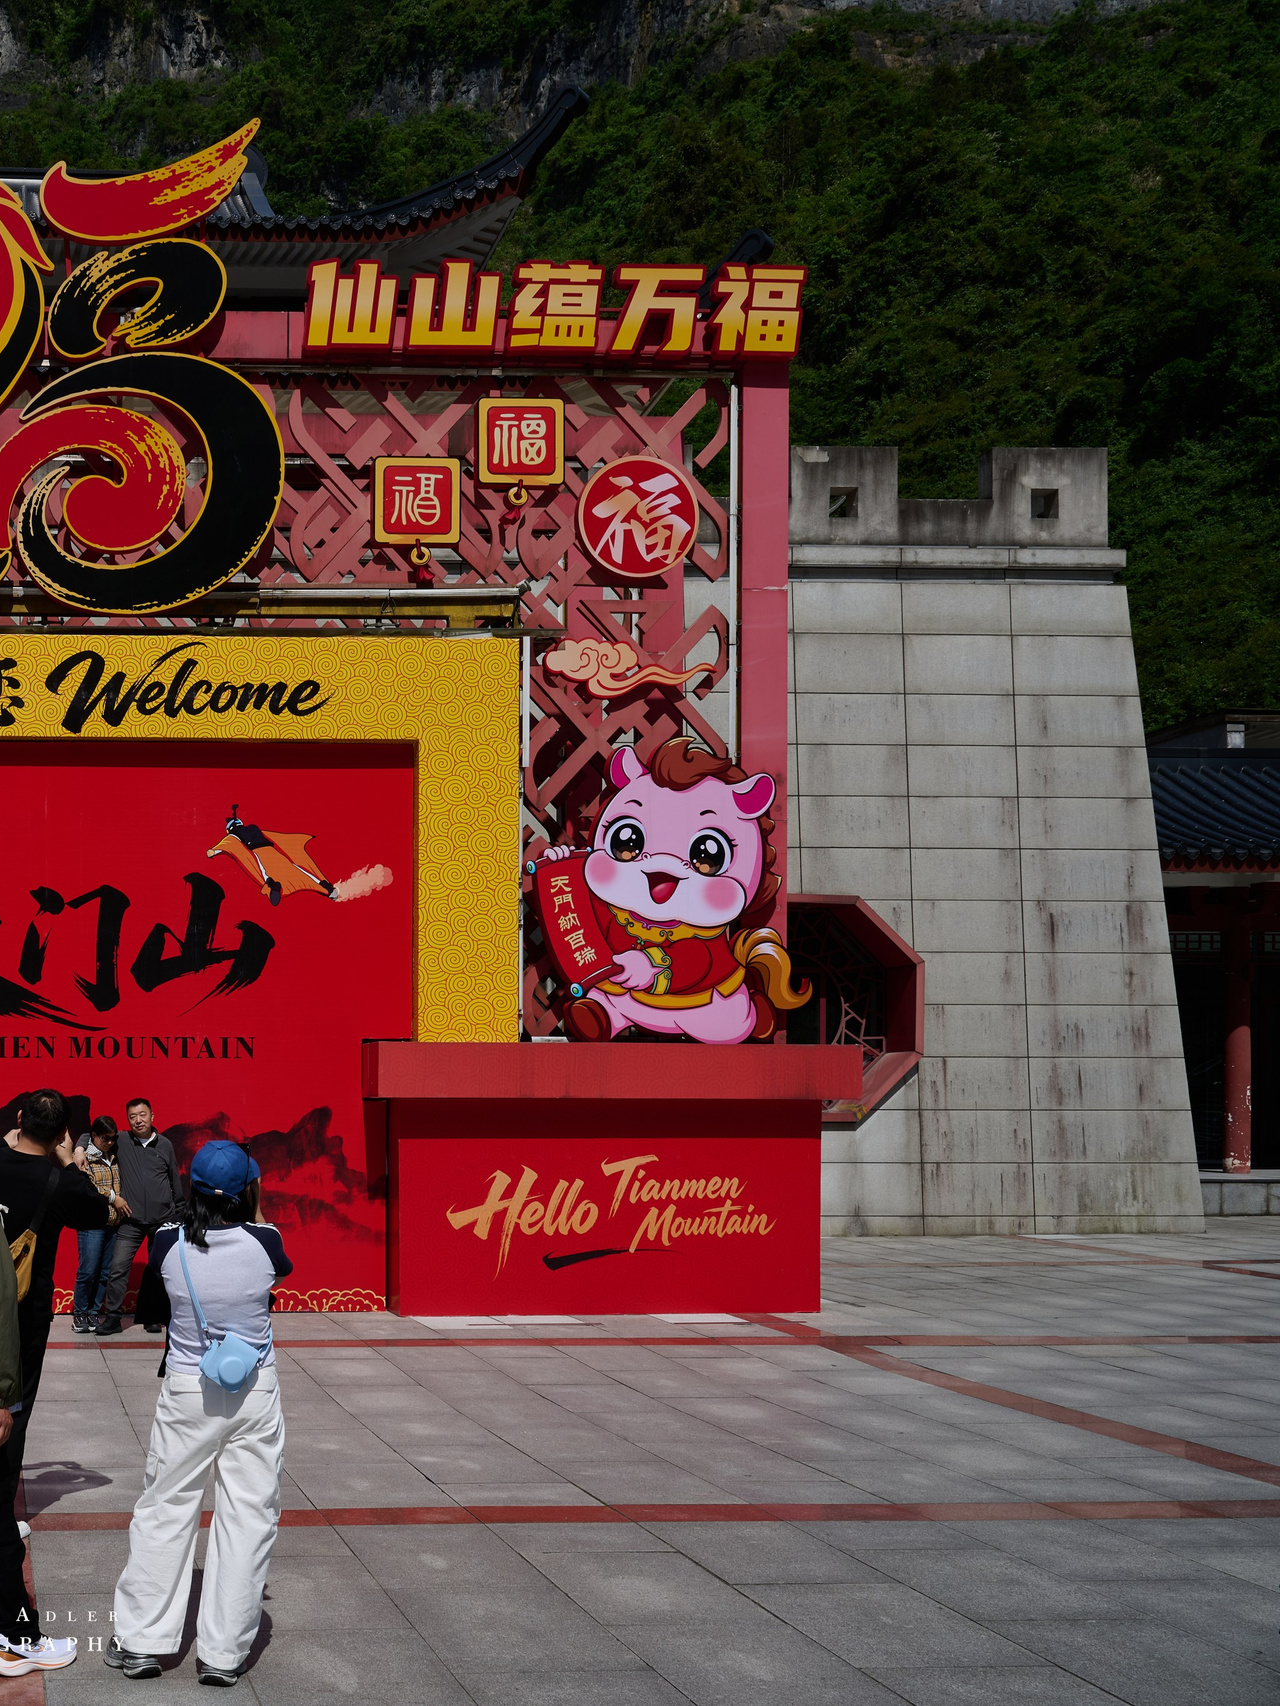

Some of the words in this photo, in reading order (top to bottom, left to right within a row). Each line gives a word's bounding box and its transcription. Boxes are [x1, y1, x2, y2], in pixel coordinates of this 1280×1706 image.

[306, 259, 807, 353] 仙山蕴万福
[492, 413, 548, 467] 福
[391, 474, 442, 526] 福
[591, 474, 692, 567] 福
[45, 641, 335, 734] Welcome
[549, 875, 598, 968] 天門納百瑞
[67, 1035, 257, 1060] MOUNTAIN
[445, 1165, 600, 1283] Hello
[600, 1154, 749, 1220] Tianmen
[628, 1199, 778, 1254] Mountain
